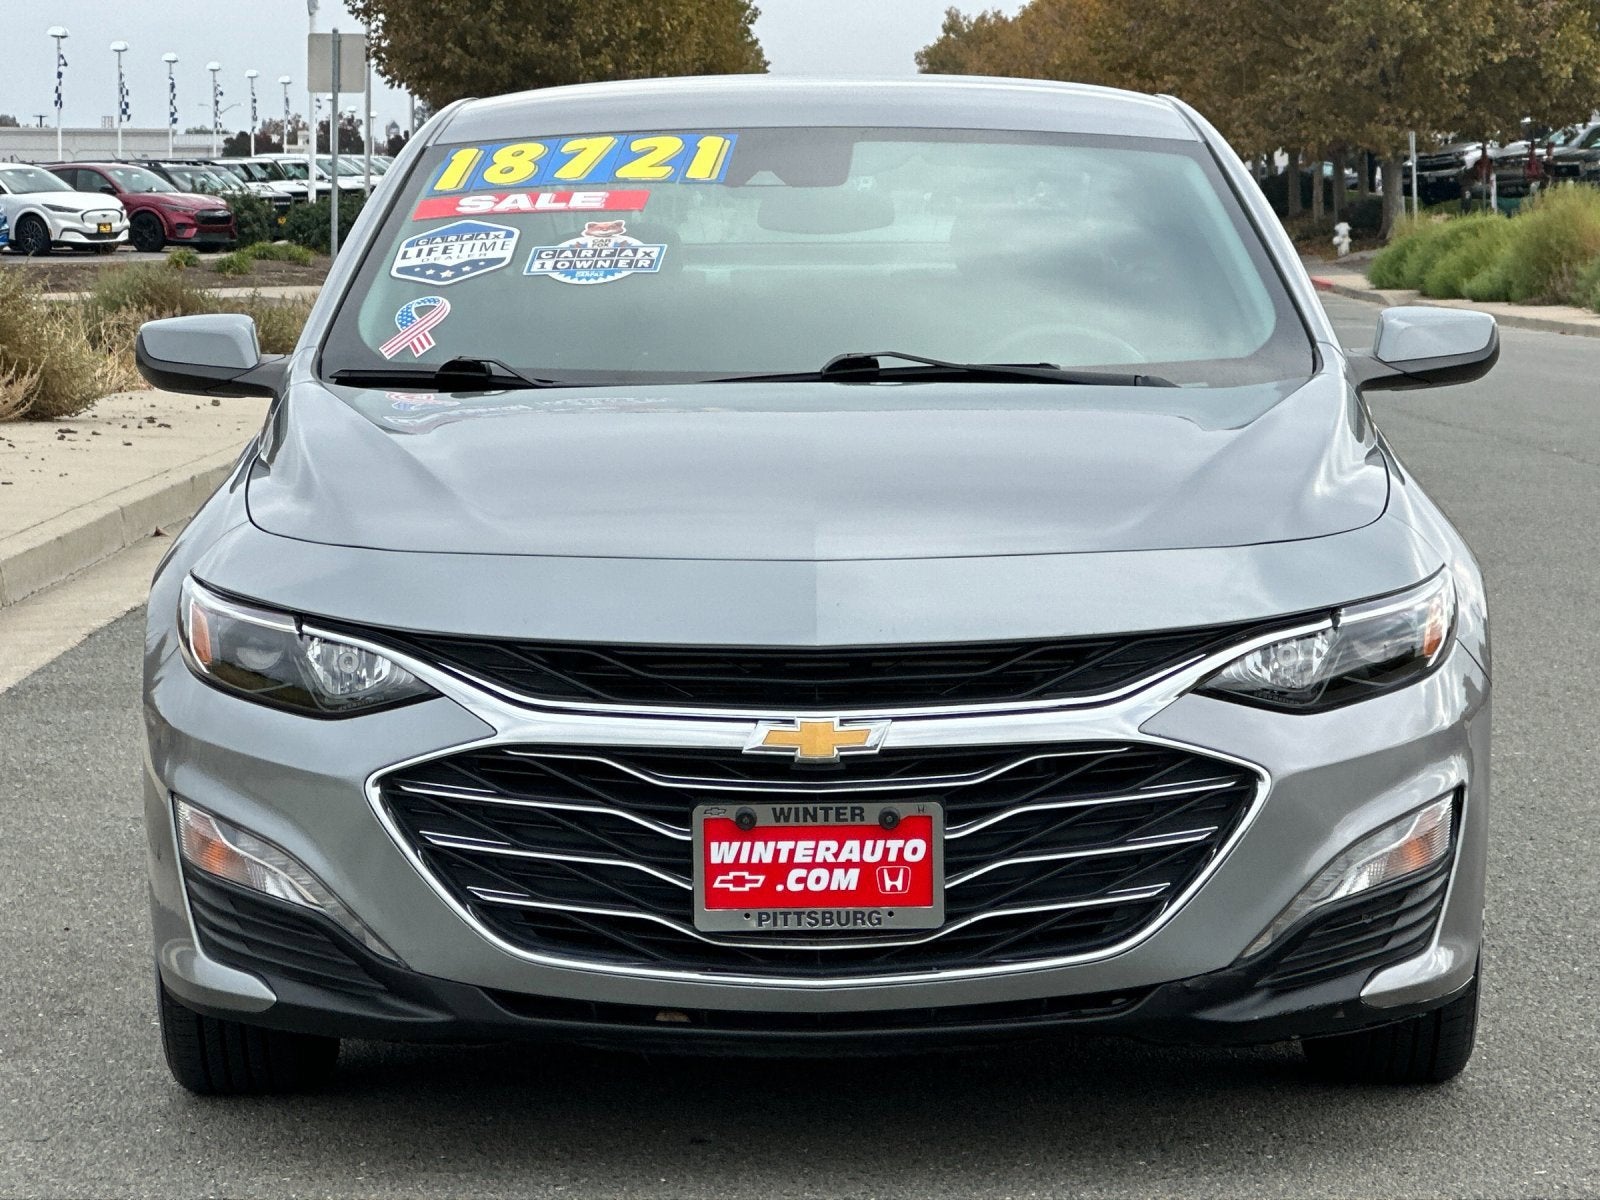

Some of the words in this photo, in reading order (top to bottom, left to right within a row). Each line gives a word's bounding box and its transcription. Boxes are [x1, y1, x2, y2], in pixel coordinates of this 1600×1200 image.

[433, 135, 731, 191] 18721
[455, 191, 610, 214] SALE
[415, 232, 505, 247] CARFAX
[400, 240, 512, 260] LIFETIME
[421, 253, 488, 263] DEALER
[538, 248, 656, 259] CARFAX
[555, 259, 651, 270] OWNER
[771, 806, 866, 824] WINTER
[709, 838, 927, 864] WINTERAUTO
[775, 868, 861, 892] .COM
[757, 911, 883, 928] PITTSBURG
